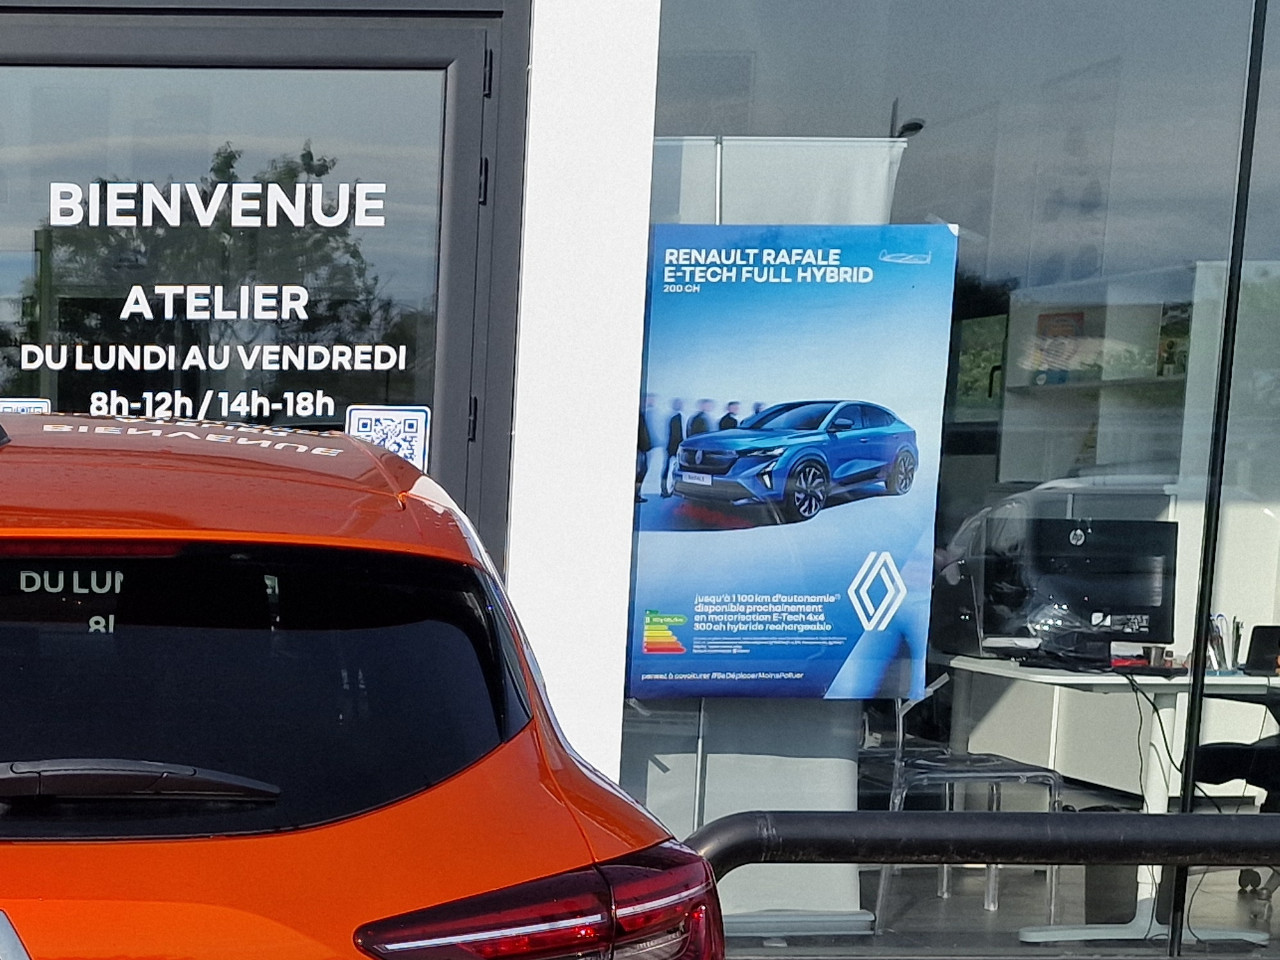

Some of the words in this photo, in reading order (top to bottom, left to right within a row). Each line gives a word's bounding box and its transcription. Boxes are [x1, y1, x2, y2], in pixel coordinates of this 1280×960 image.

[48, 181, 388, 229] BIENVENUE
[664, 248, 759, 265] RENAULT
[761, 248, 842, 265] RAFALE
[663, 266, 737, 283] E-TECH
[741, 267, 793, 283] FULL
[796, 267, 874, 284] HYBRID
[685, 284, 701, 293] CH
[118, 284, 310, 321] ATELIER
[20, 344, 68, 371] DU
[74, 345, 176, 371] LUNDI
[181, 345, 230, 371] AU
[240, 345, 407, 371] VENDREDI
[20, 570, 64, 593] DU
[755, 594, 771, 603] km
[694, 603, 745, 614] disponible
[746, 603, 824, 614] prochainement
[694, 614, 707, 622] en
[707, 613, 772, 622] motorisation
[772, 613, 806, 622] E-Tech
[806, 613, 826, 622] 4x4
[726, 622, 765, 633] hybride
[765, 622, 833, 633] rechargeable
